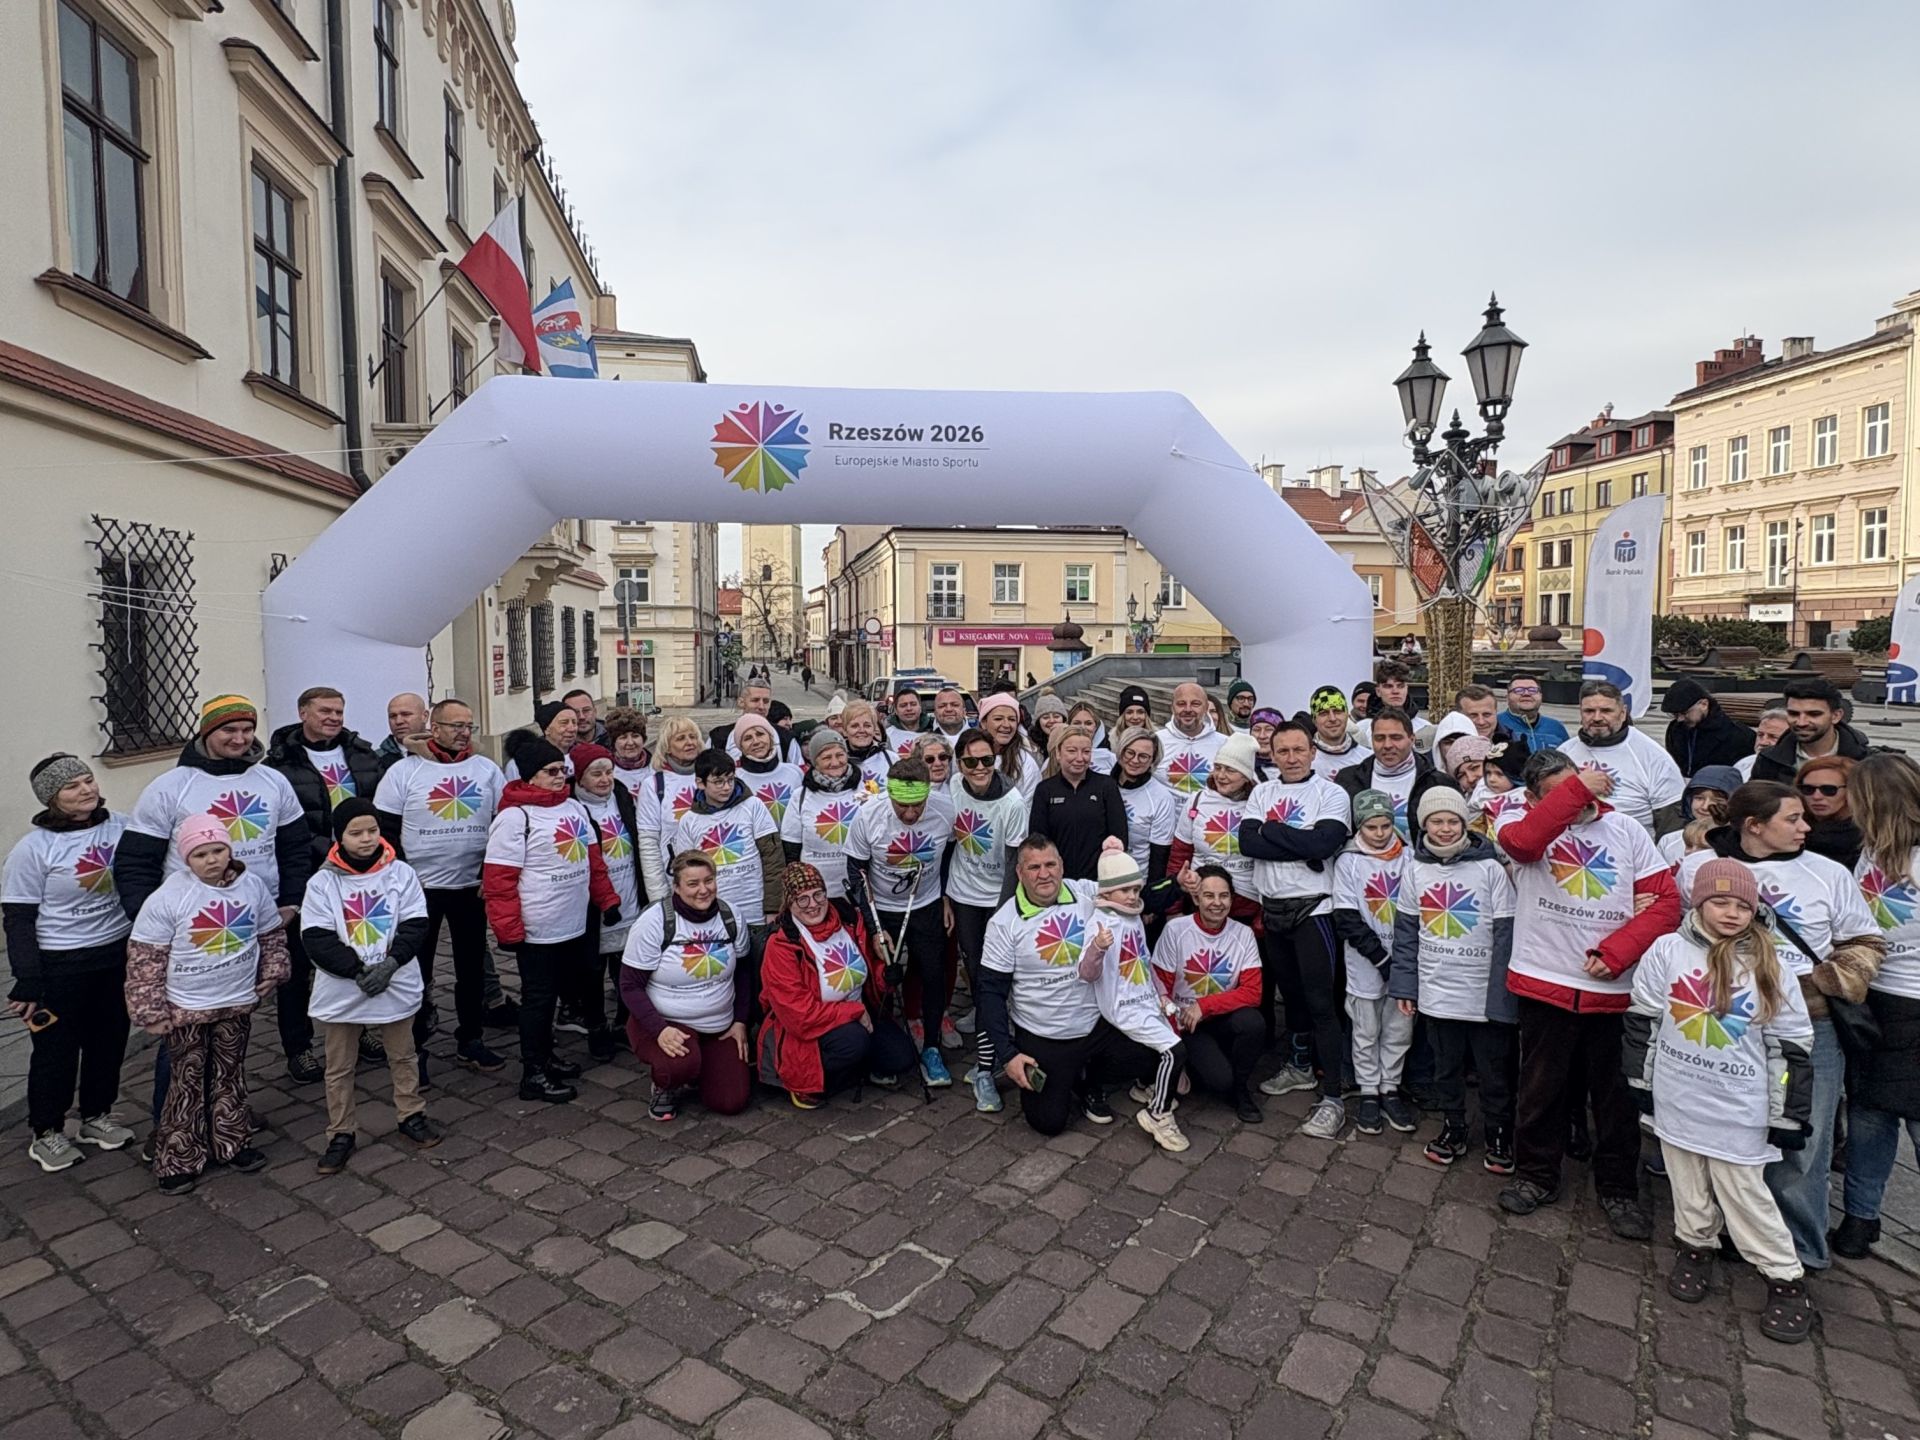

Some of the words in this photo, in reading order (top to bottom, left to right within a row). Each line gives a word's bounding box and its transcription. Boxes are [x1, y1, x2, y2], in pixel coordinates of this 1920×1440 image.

[829, 422, 924, 442] Rzeszów
[930, 425, 984, 443] 2026
[835, 455, 899, 469] Europejskie
[902, 456, 939, 467] Miasto
[942, 456, 979, 469] Sportu
[1605, 568, 1622, 576] Bank
[959, 632, 1006, 642] KSIĘGARNIE
[1008, 632, 1029, 641] NOVA
[419, 824, 465, 836] Rzeszów
[467, 825, 487, 834] 2026
[1538, 896, 1595, 919] Rzeszów
[1597, 909, 1626, 922] 2026
[1458, 946, 1487, 958] 2026
[1659, 1038, 1715, 1070] Rzeszów
[1719, 1061, 1757, 1078] 2026
